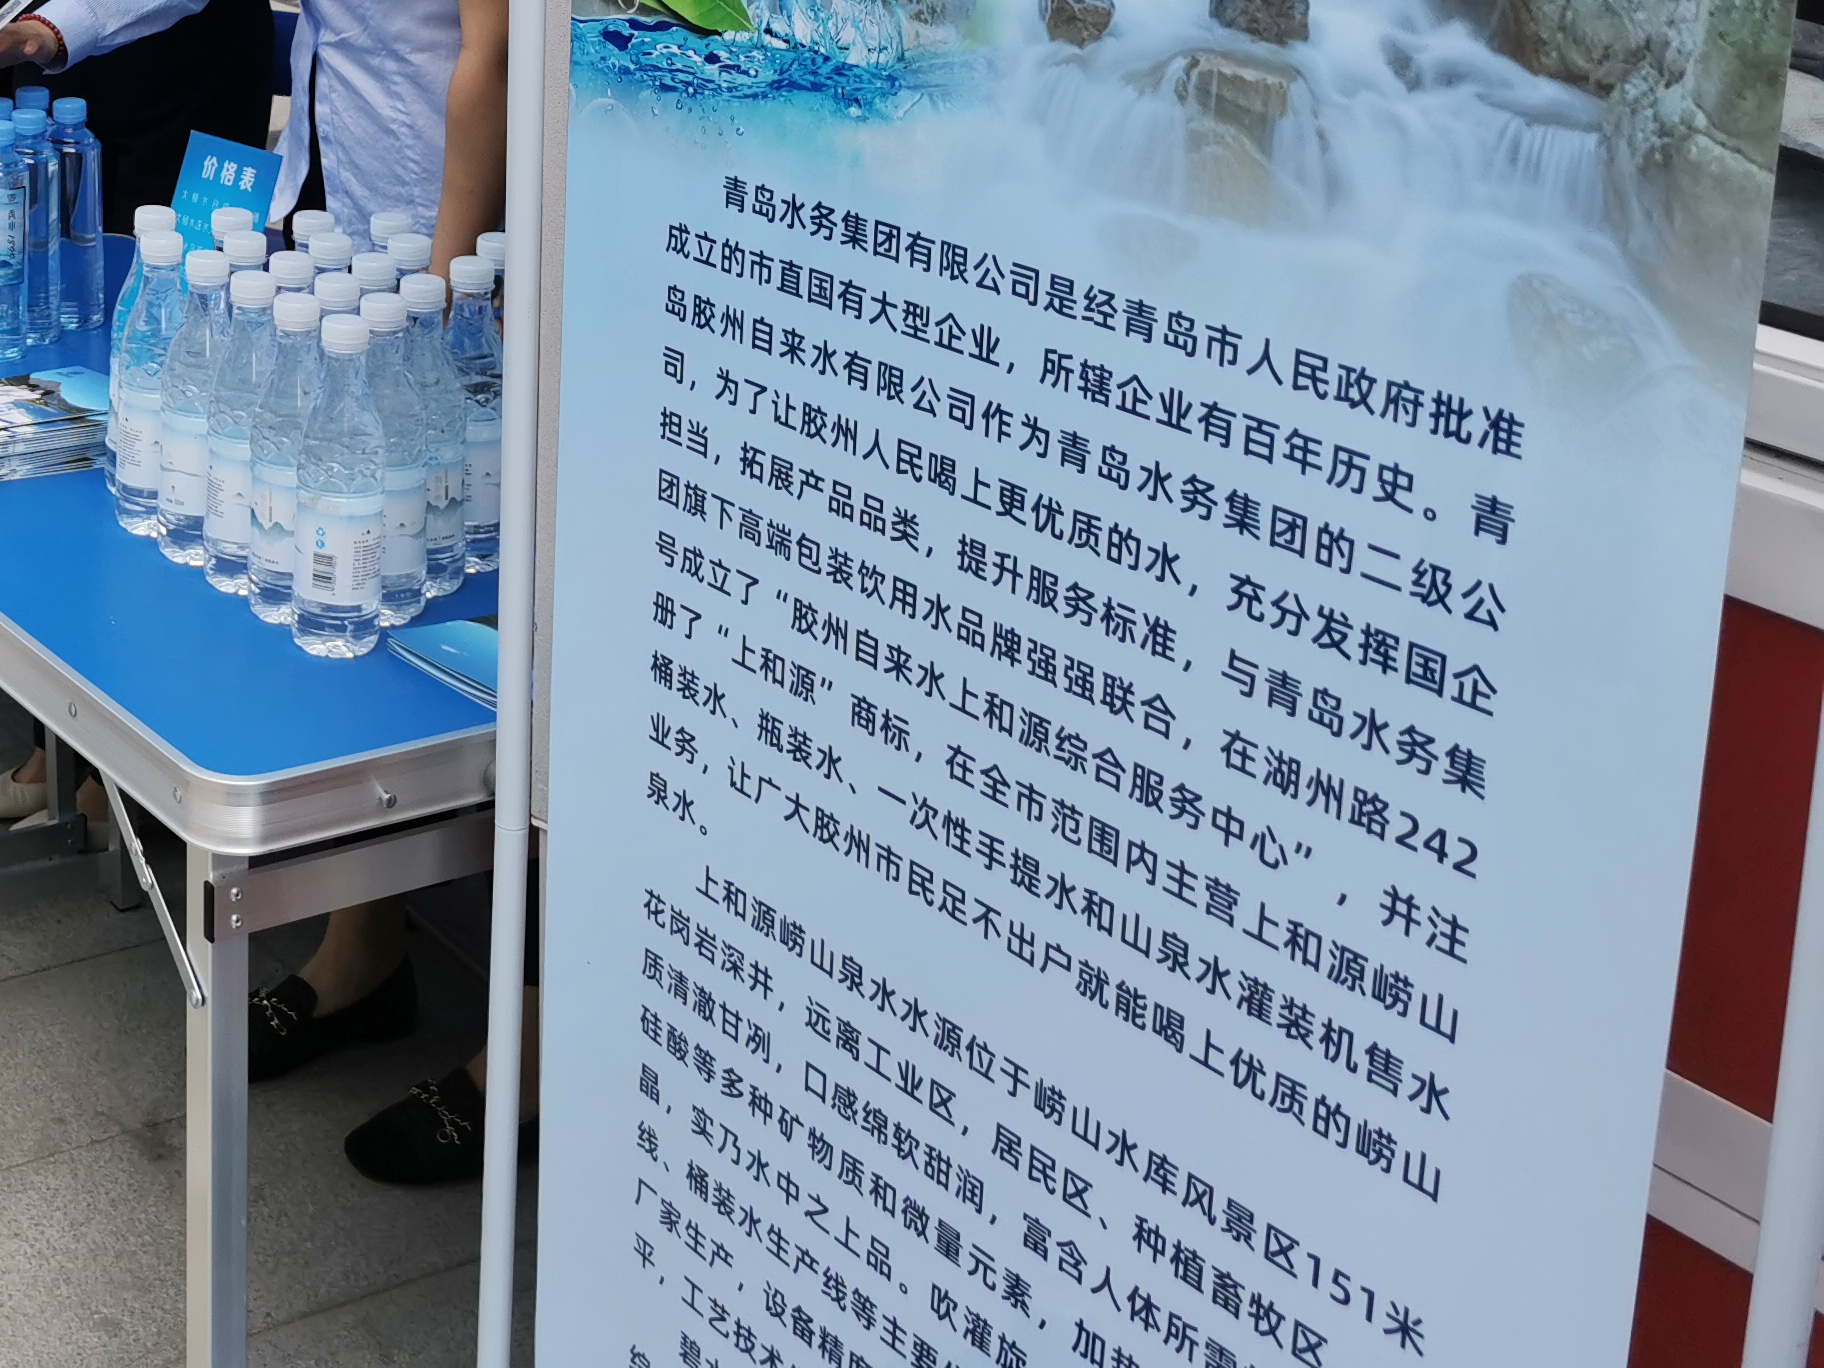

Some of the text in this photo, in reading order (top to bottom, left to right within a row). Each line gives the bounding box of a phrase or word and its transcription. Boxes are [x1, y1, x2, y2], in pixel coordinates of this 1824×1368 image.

[201, 155, 257, 192] 价格表
[665, 223, 1516, 545] 成立的市直国有大型企业，所辖企业有百年历史。青
[723, 175, 1525, 460] 青岛水务集团有限公司是经青岛市人民政府批准
[664, 284, 1507, 632] 岛胶州自来水有限公司作为青岛水务集团的二级公
[646, 771, 709, 836] 泉水。
[636, 1120, 961, 1368] 线、桶装水生产线等主要
